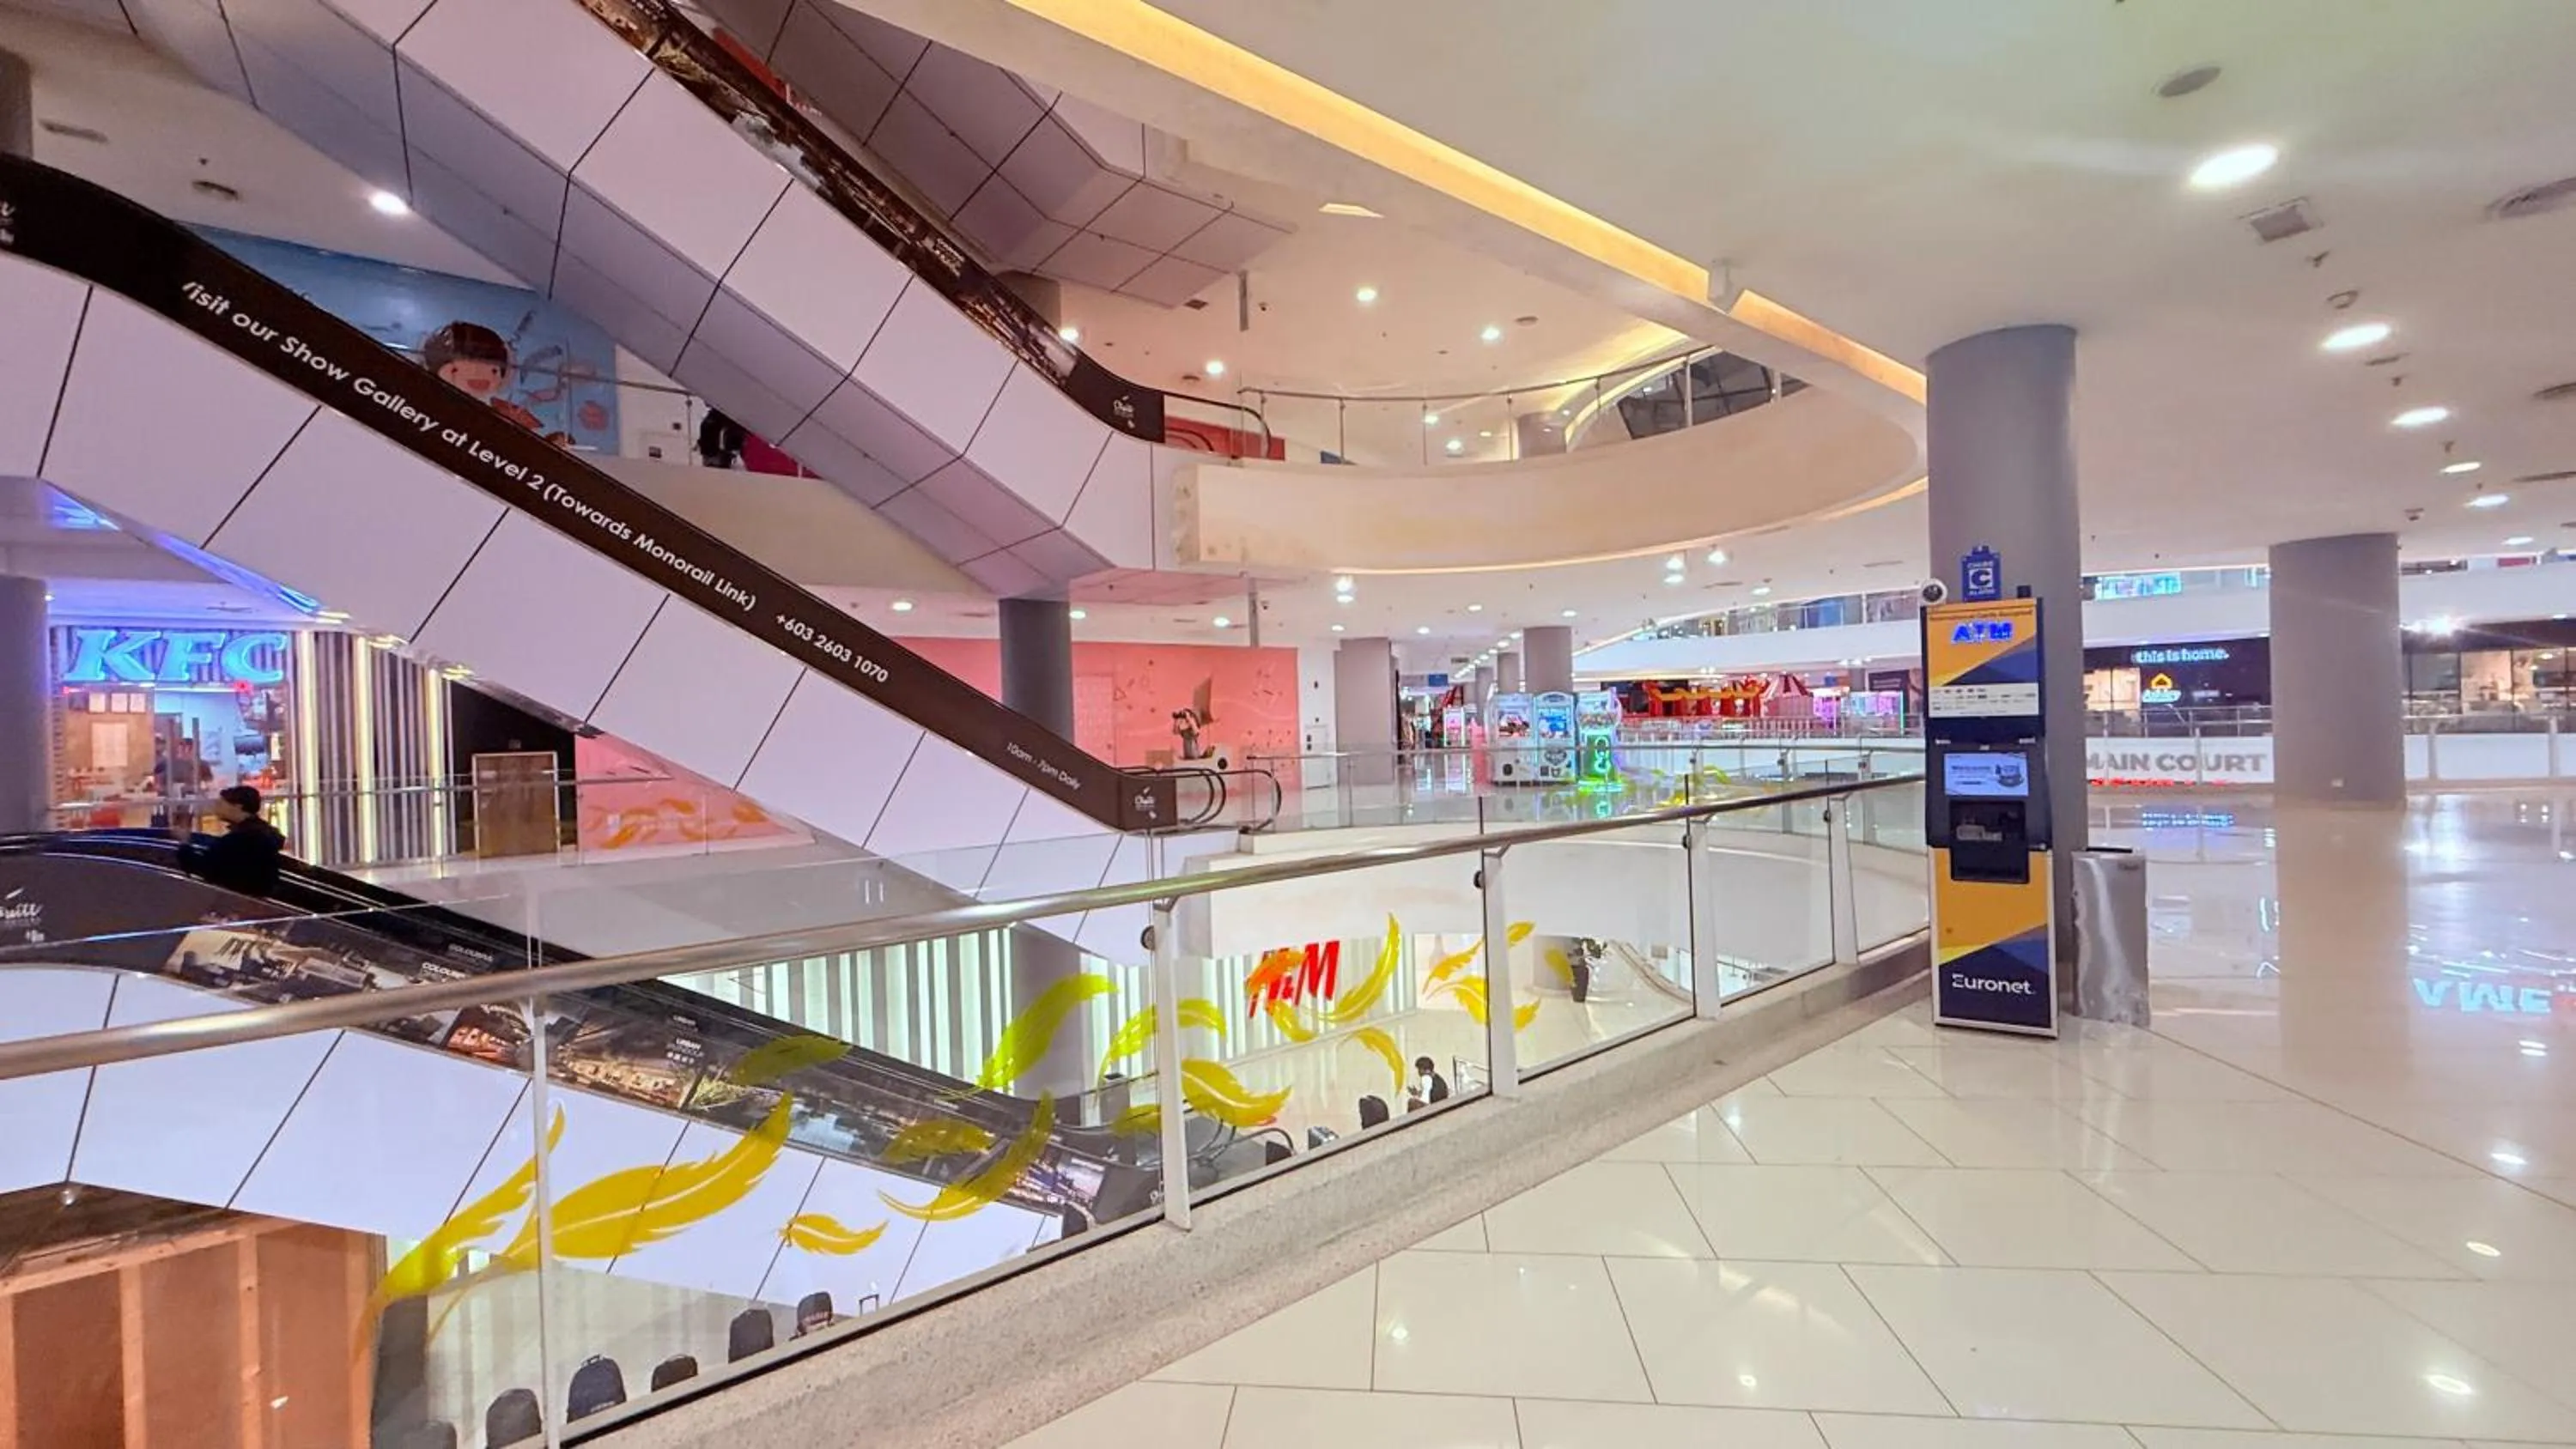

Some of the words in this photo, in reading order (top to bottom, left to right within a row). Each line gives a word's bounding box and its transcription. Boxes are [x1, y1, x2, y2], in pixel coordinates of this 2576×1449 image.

[232, 312, 279, 342] our
[279, 336, 350, 381] Show
[353, 377, 440, 433] Gallery
[441, 427, 469, 448] at
[468, 440, 529, 482] Level
[527, 473, 545, 490] 2
[543, 482, 633, 541] (Towards
[633, 532, 716, 587] Monorail
[714, 577, 757, 611] Link)
[775, 612, 815, 642] +603
[813, 634, 854, 663] 2603
[854, 654, 890, 684] 1070
[1952, 620, 2014, 643] ATM
[64, 628, 288, 684] KFC
[2136, 650, 2165, 664] this
[2155, 753, 2268, 772] COURT
[1951, 972, 2034, 996] Euronet
